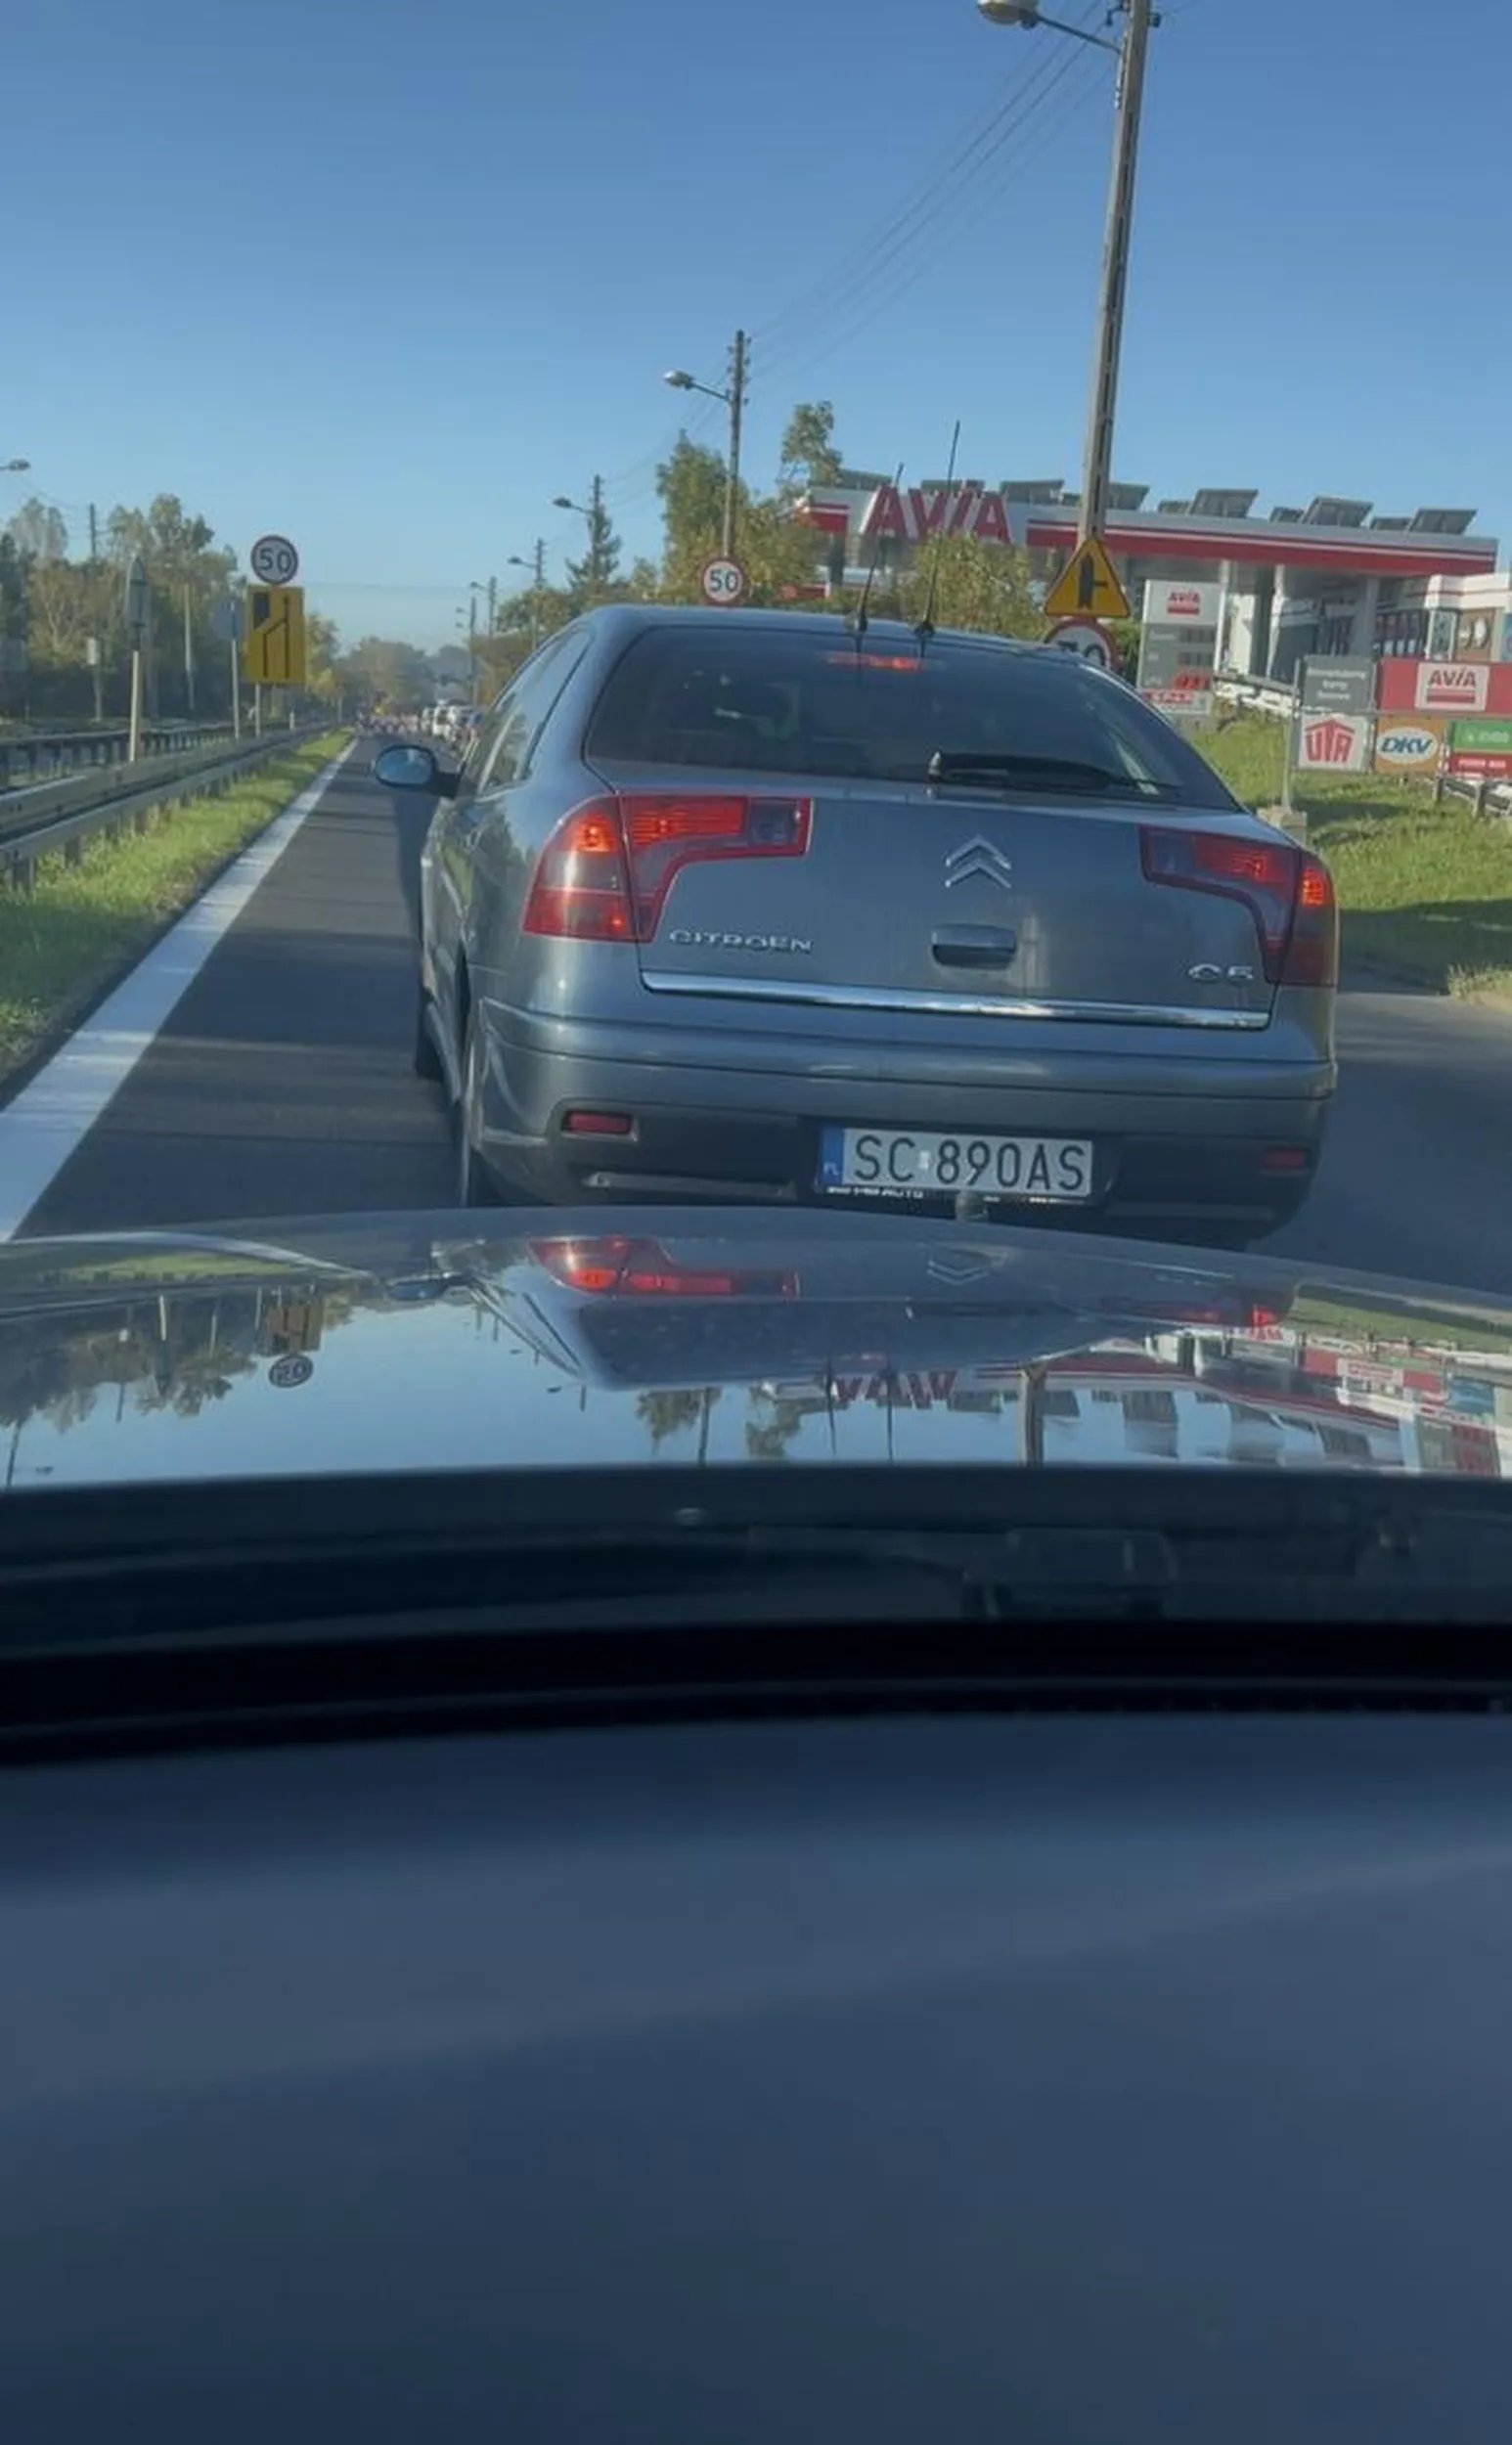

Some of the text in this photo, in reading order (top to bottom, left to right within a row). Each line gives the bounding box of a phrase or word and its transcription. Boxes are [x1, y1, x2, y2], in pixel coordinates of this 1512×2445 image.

[259, 548, 291, 573] 50
[709, 569, 739, 593] 50
[1305, 719, 1355, 763] UTA
[1380, 736, 1433, 754] DKV
[1188, 963, 1254, 981] C5
[854, 1134, 1086, 1191] SC 890AS
